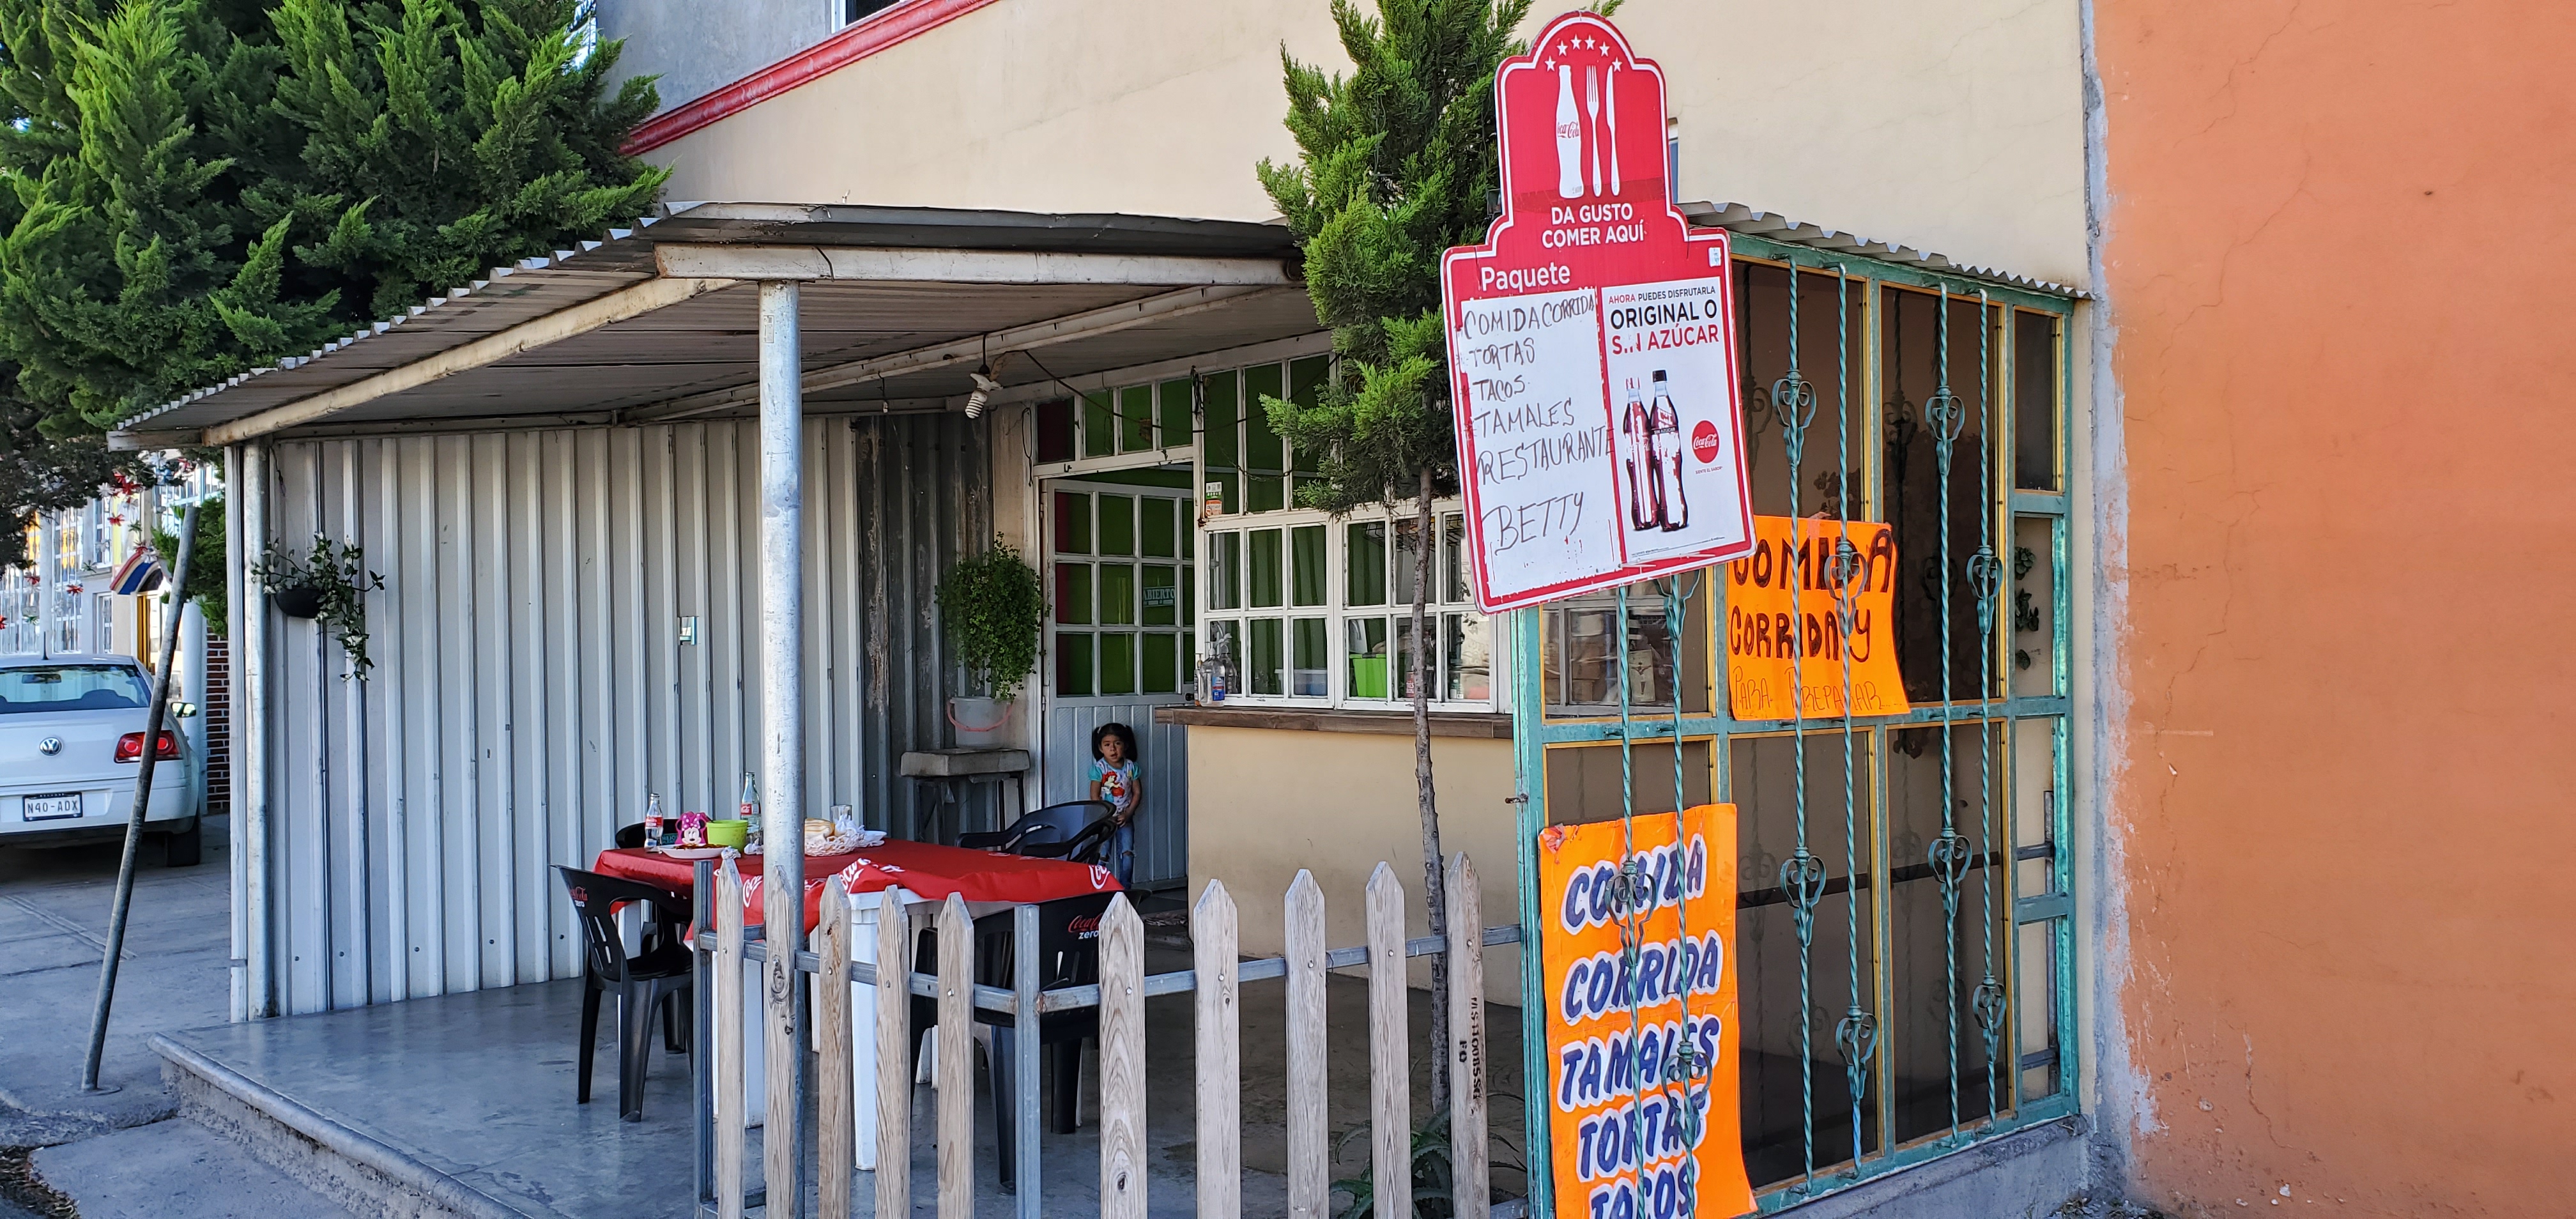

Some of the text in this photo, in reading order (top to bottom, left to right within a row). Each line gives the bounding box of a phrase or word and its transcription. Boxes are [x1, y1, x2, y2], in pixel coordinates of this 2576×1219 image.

[1551, 203, 1633, 225] DA GUSTO
[1542, 219, 1644, 249] COMER AQUÍ
[1481, 261, 1570, 293] Paquete
[1609, 286, 1715, 304] AHORA PUEDES DISFRUTARLA
[1464, 295, 1595, 339] COMIDA CORRIDA
[1611, 299, 1717, 330] ORIGINAL O
[1648, 323, 1719, 351] AZÚCAR
[1469, 337, 1535, 371] TORTAS
[1473, 375, 1526, 402] TACOS
[1474, 397, 1574, 438] TAMALES
[1477, 425, 1614, 486] RESTAURANTE
[1694, 433, 1717, 450] Coca-Cola
[1482, 491, 1584, 556] BETTY
[27, 801, 78, 814] N40-ADX
[1078, 930, 1099, 939] zero
[1565, 937, 1719, 1018] CORRIDA
